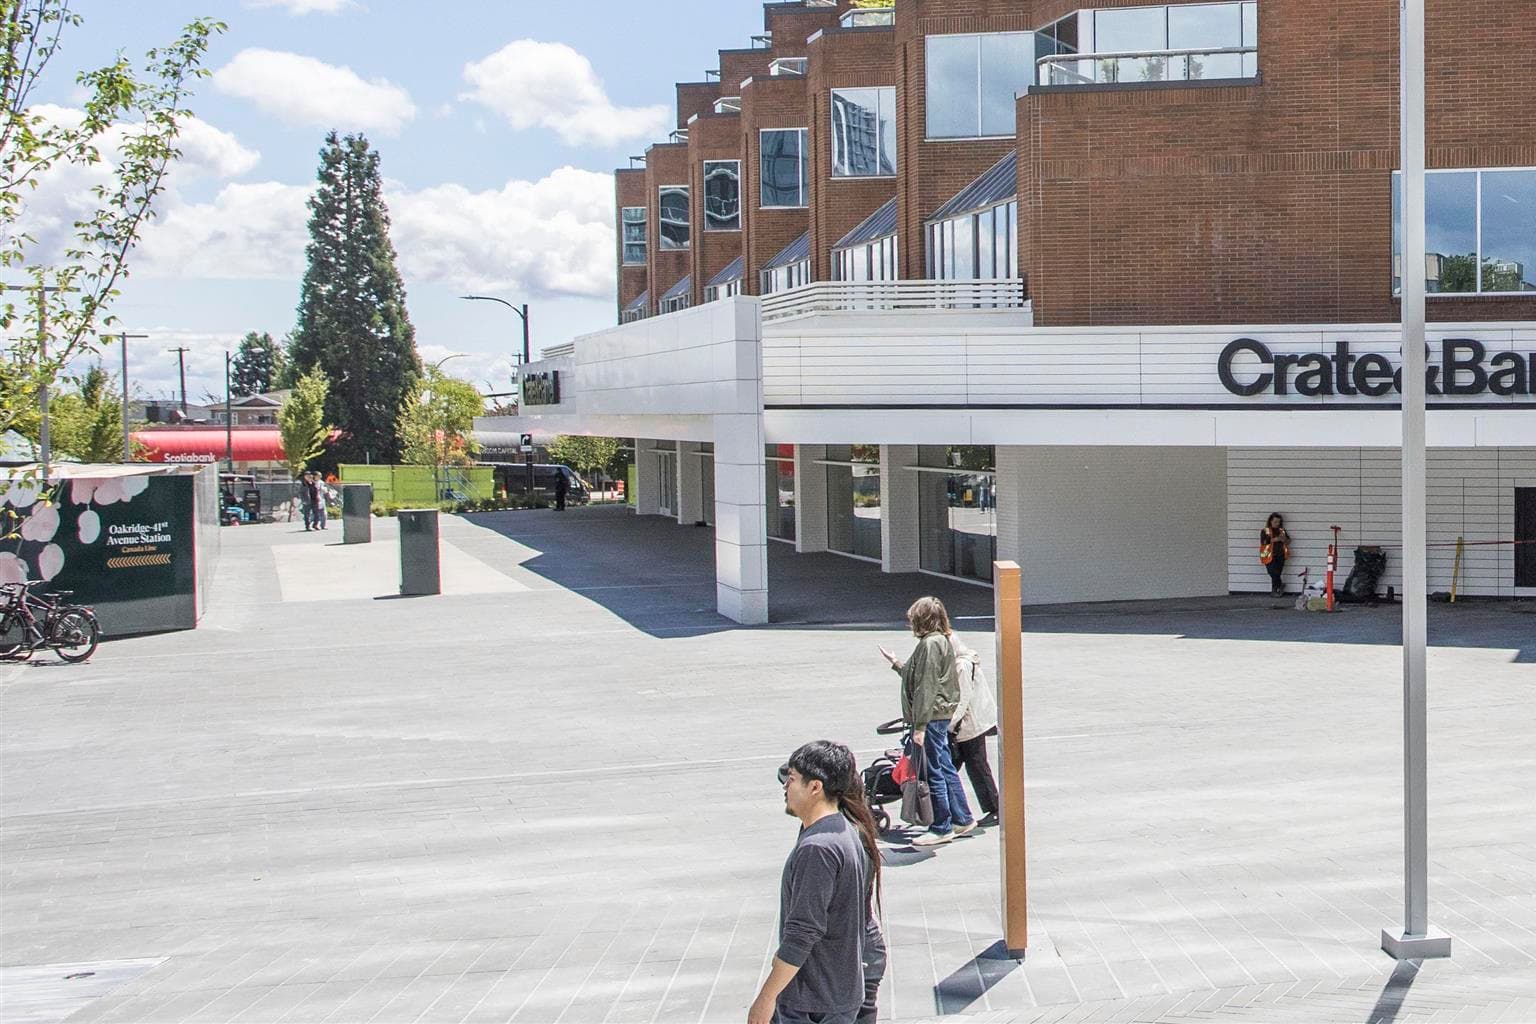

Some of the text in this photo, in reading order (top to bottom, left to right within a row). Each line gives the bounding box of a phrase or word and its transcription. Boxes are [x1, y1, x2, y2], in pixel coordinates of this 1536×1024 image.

[164, 452, 216, 462] Scotiabank
[106, 533, 172, 545] Avenue Station
